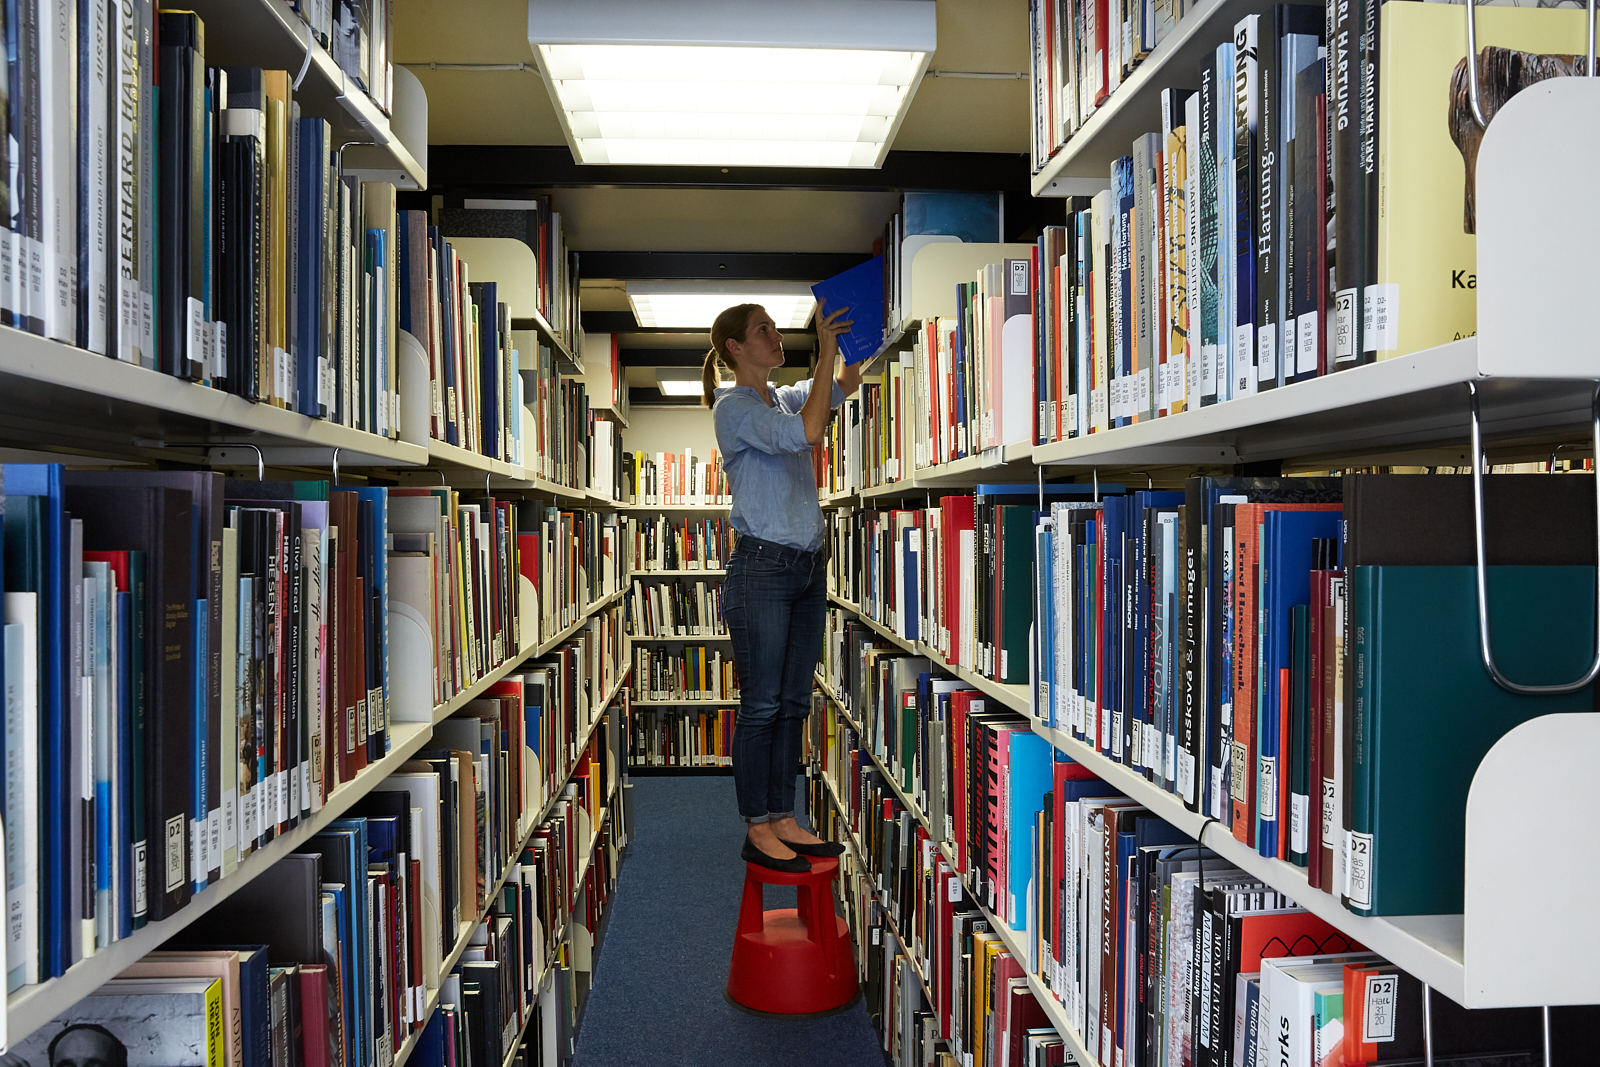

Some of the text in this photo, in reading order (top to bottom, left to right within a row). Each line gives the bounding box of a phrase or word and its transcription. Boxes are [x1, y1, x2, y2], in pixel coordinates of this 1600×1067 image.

[1202, 68, 1211, 144] Hartung
[1235, 27, 1249, 170] HARTUNG
[1337, 30, 1349, 131] HARTUNG
[1365, 62, 1375, 175] KARL HARTUNG
[31, 187, 39, 218] Family
[1136, 150, 1144, 205] Druckgraphik
[1258, 151, 1275, 258] Hartung
[1121, 212, 1129, 243] Hartung
[1190, 249, 1198, 310] POLITTICI
[1337, 298, 1350, 312] D2
[268, 556, 275, 579] HE
[1238, 542, 1246, 588] Ernst
[1186, 548, 1196, 646] janmaget
[1154, 602, 1163, 709] HASIOR
[1236, 750, 1245, 762] D2
[974, 728, 982, 849] Keith Haring
[169, 822, 181, 839] D2
[1351, 841, 1367, 855] D2
[1104, 823, 1112, 913] HATMANU
[1202, 918, 1211, 1041] MONA HATOUM
[1211, 933, 1221, 1053] MONA HATOUM:
[1373, 982, 1391, 994] D2
[1250, 999, 1259, 1035] Heide
[1259, 994, 1270, 1036] THE
